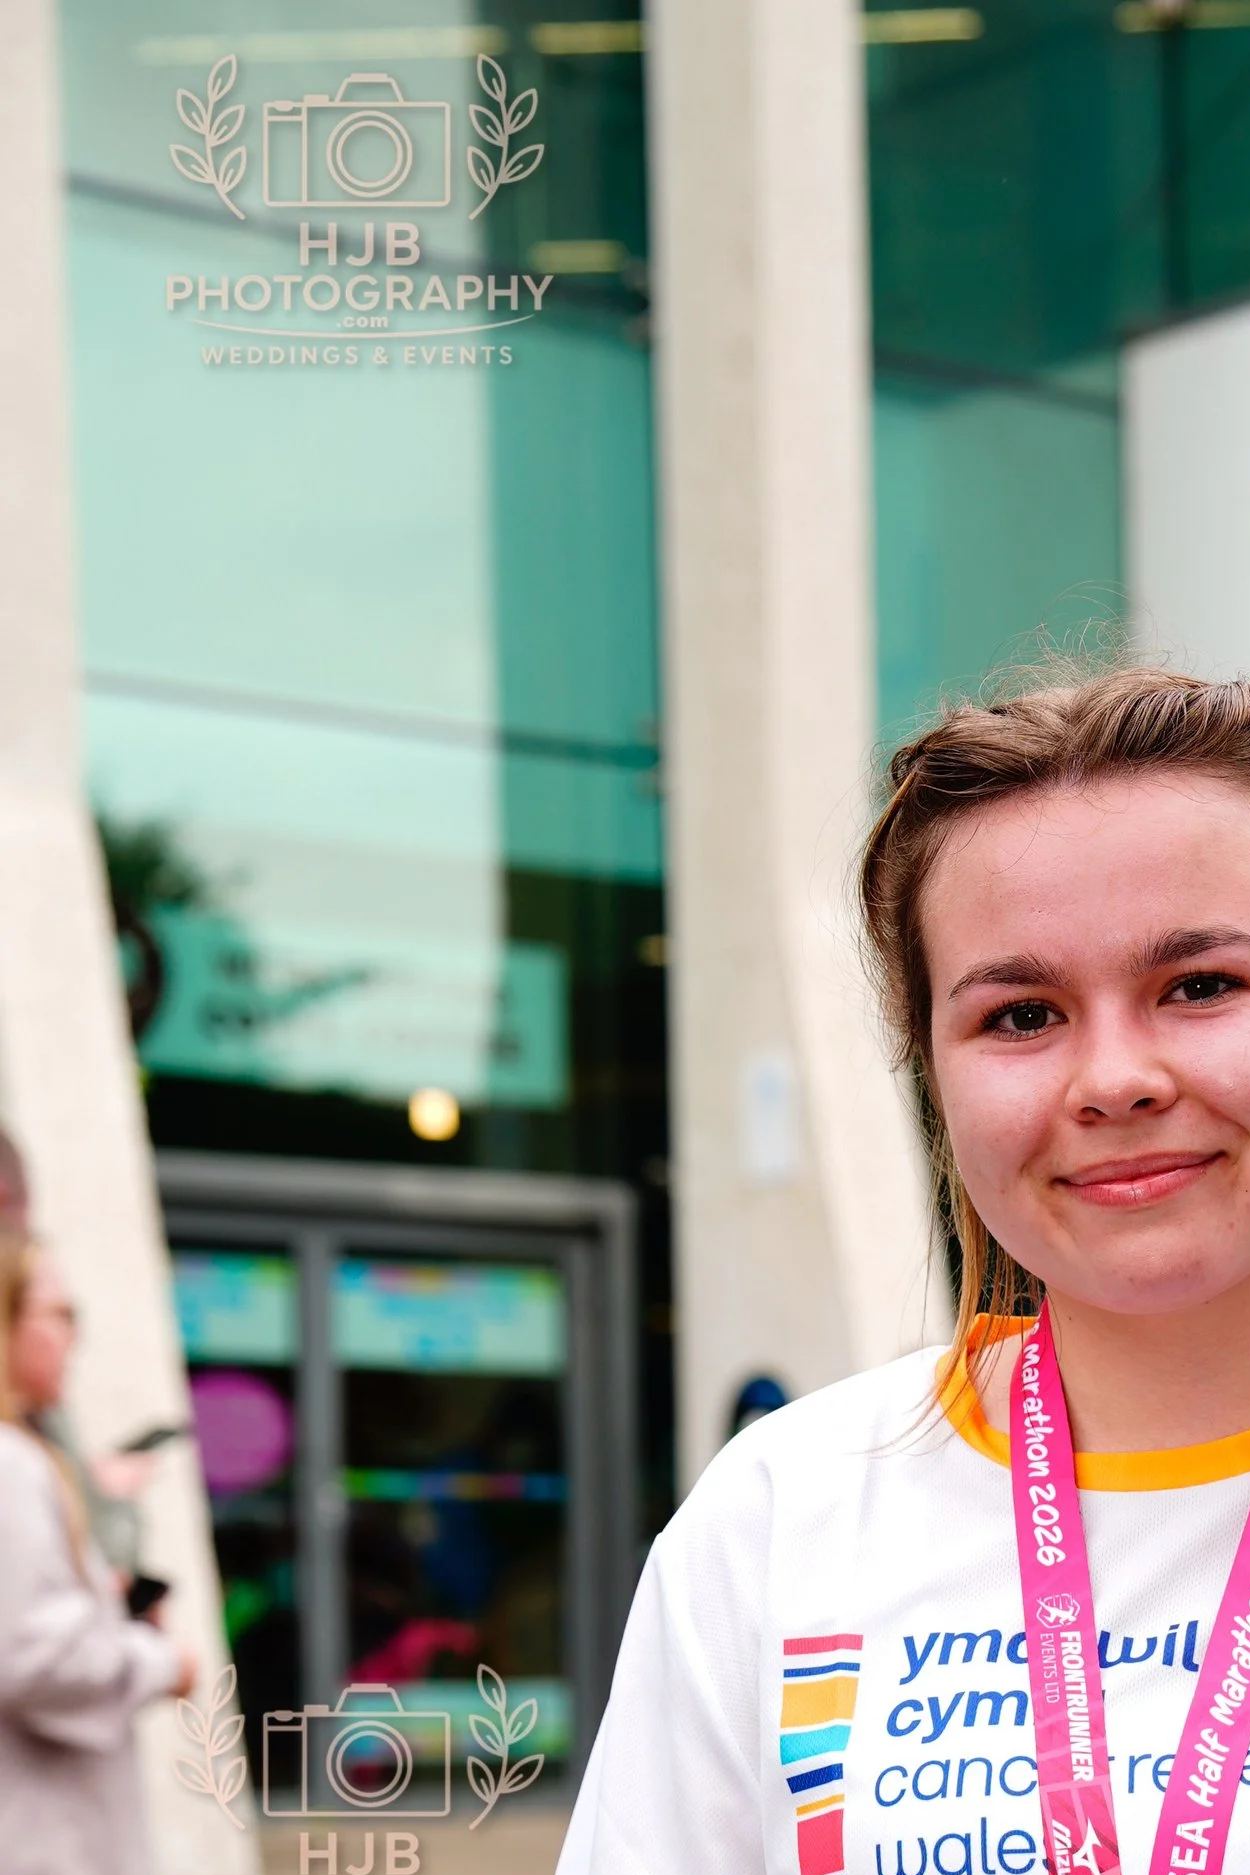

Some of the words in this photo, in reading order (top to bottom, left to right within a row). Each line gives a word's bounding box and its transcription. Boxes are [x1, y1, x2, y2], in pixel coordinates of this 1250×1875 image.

[1021, 1342, 1055, 1478] Marathon
[1028, 1483, 1066, 1567] 2026
[900, 1620, 1199, 1685] ymcwil
[1039, 1633, 1058, 1682] EVENTS
[1045, 1684, 1060, 1704] LTD
[1060, 1631, 1095, 1783] FRONTRUNNER
[1186, 1728, 1231, 1808] Half
